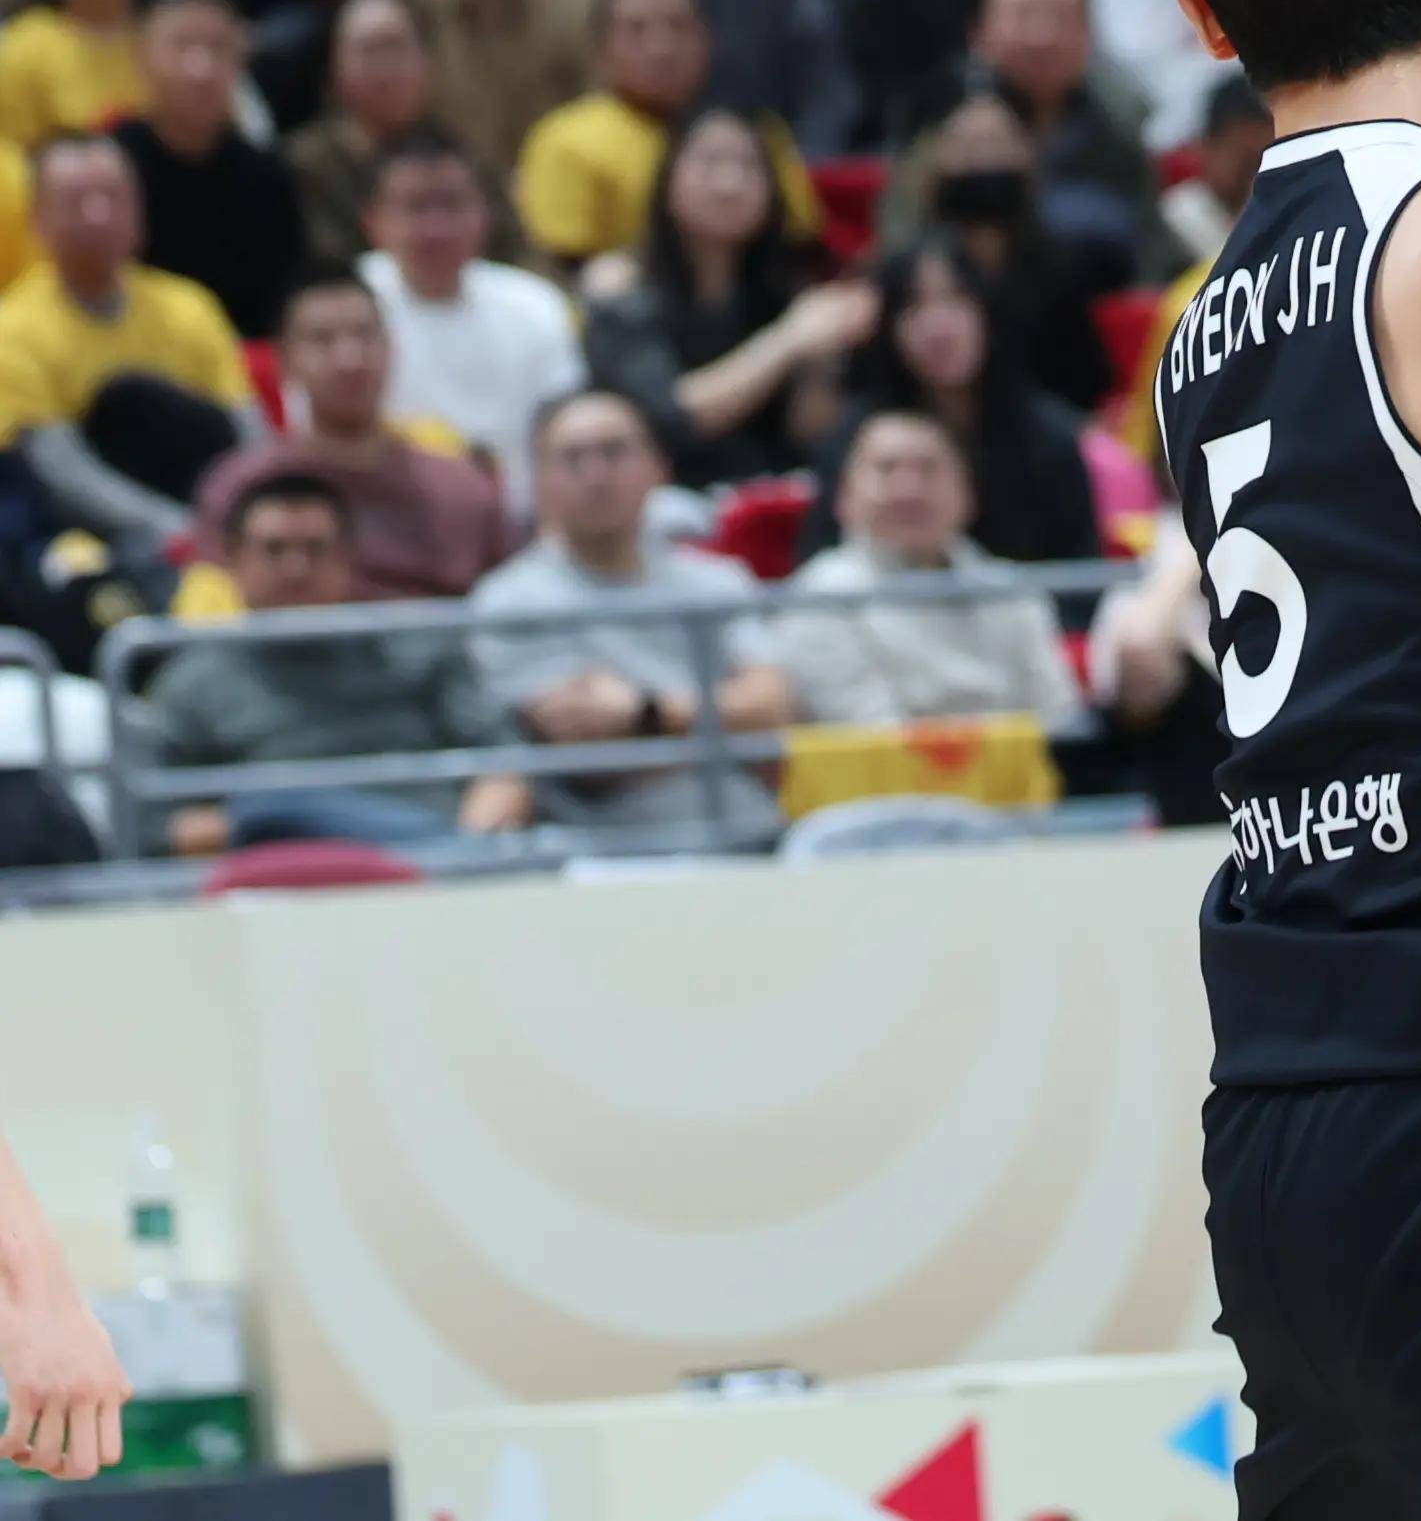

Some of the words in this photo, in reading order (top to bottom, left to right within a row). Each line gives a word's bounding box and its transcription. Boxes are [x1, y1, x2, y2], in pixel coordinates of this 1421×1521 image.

[1171, 253, 1279, 395] BYEON
[1276, 226, 1347, 336] JH
[1200, 419, 1308, 739] 5
